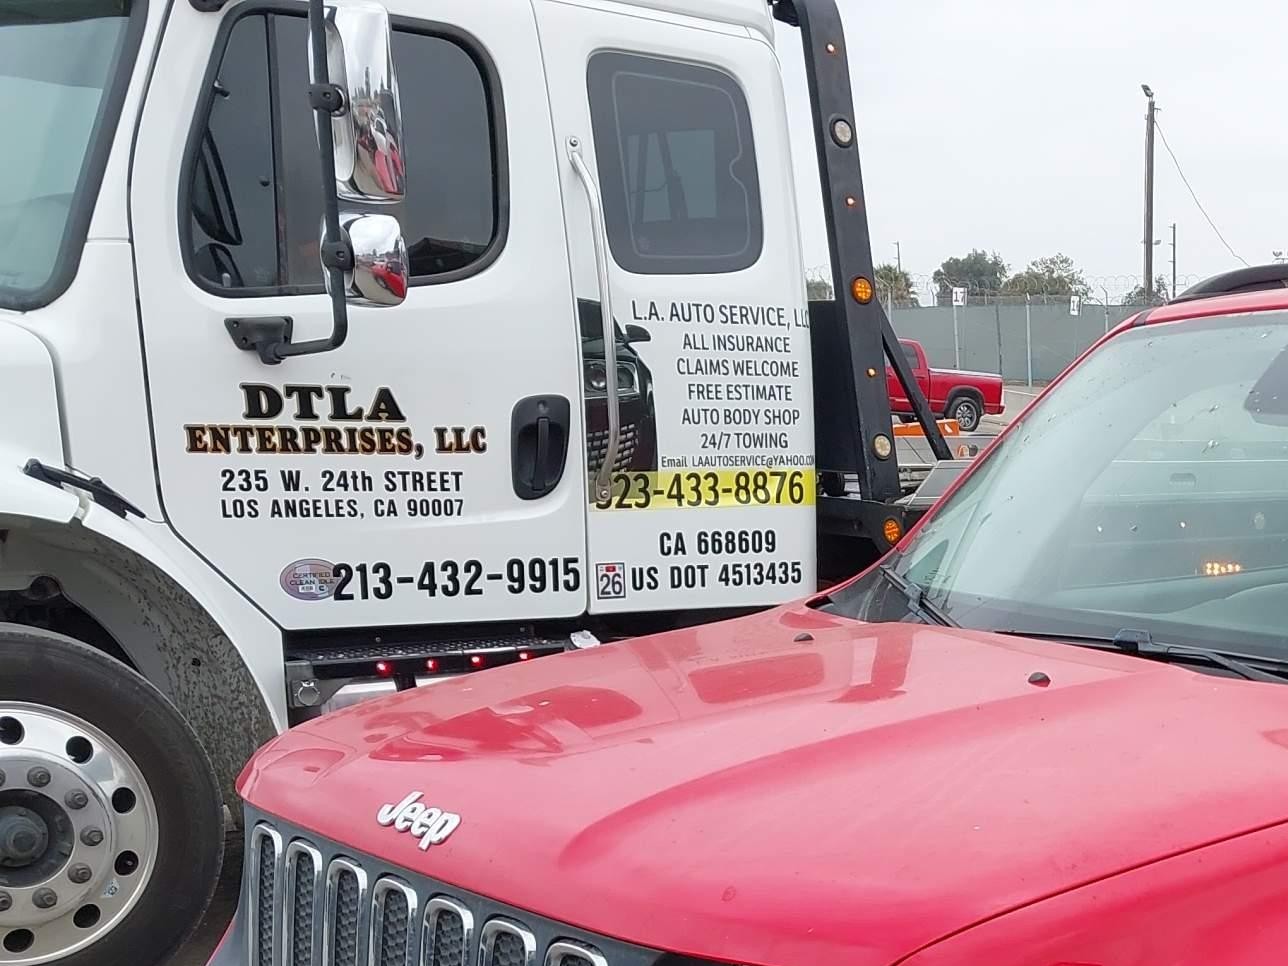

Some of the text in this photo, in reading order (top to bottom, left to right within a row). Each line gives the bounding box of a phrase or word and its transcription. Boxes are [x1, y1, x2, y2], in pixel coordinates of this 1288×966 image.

[632, 300, 665, 322] L.A.
[669, 303, 715, 324] AUTO
[719, 305, 790, 331] SERVICE,
[683, 333, 791, 353] ALL INSURANCE
[676, 358, 799, 378] CLAIMS WELCOME
[238, 381, 407, 423] DTLA
[688, 383, 792, 402] FREE ESTIMATE
[681, 408, 800, 426] AUTO BODY SHOP
[183, 424, 489, 459] ENTERPRISES, LLC
[700, 432, 789, 450] 24/7 TOWING
[661, 456, 688, 468] Email
[221, 470, 464, 492] 235 W. 24th STREET
[221, 499, 464, 520] LOS ANGELES, CA 90007
[659, 530, 777, 556] CA 668609
[333, 557, 581, 601] 213-432-9915
[600, 573, 623, 595] 26
[632, 562, 802, 591] US DOT 4513435
[377, 790, 462, 852] Jeep
